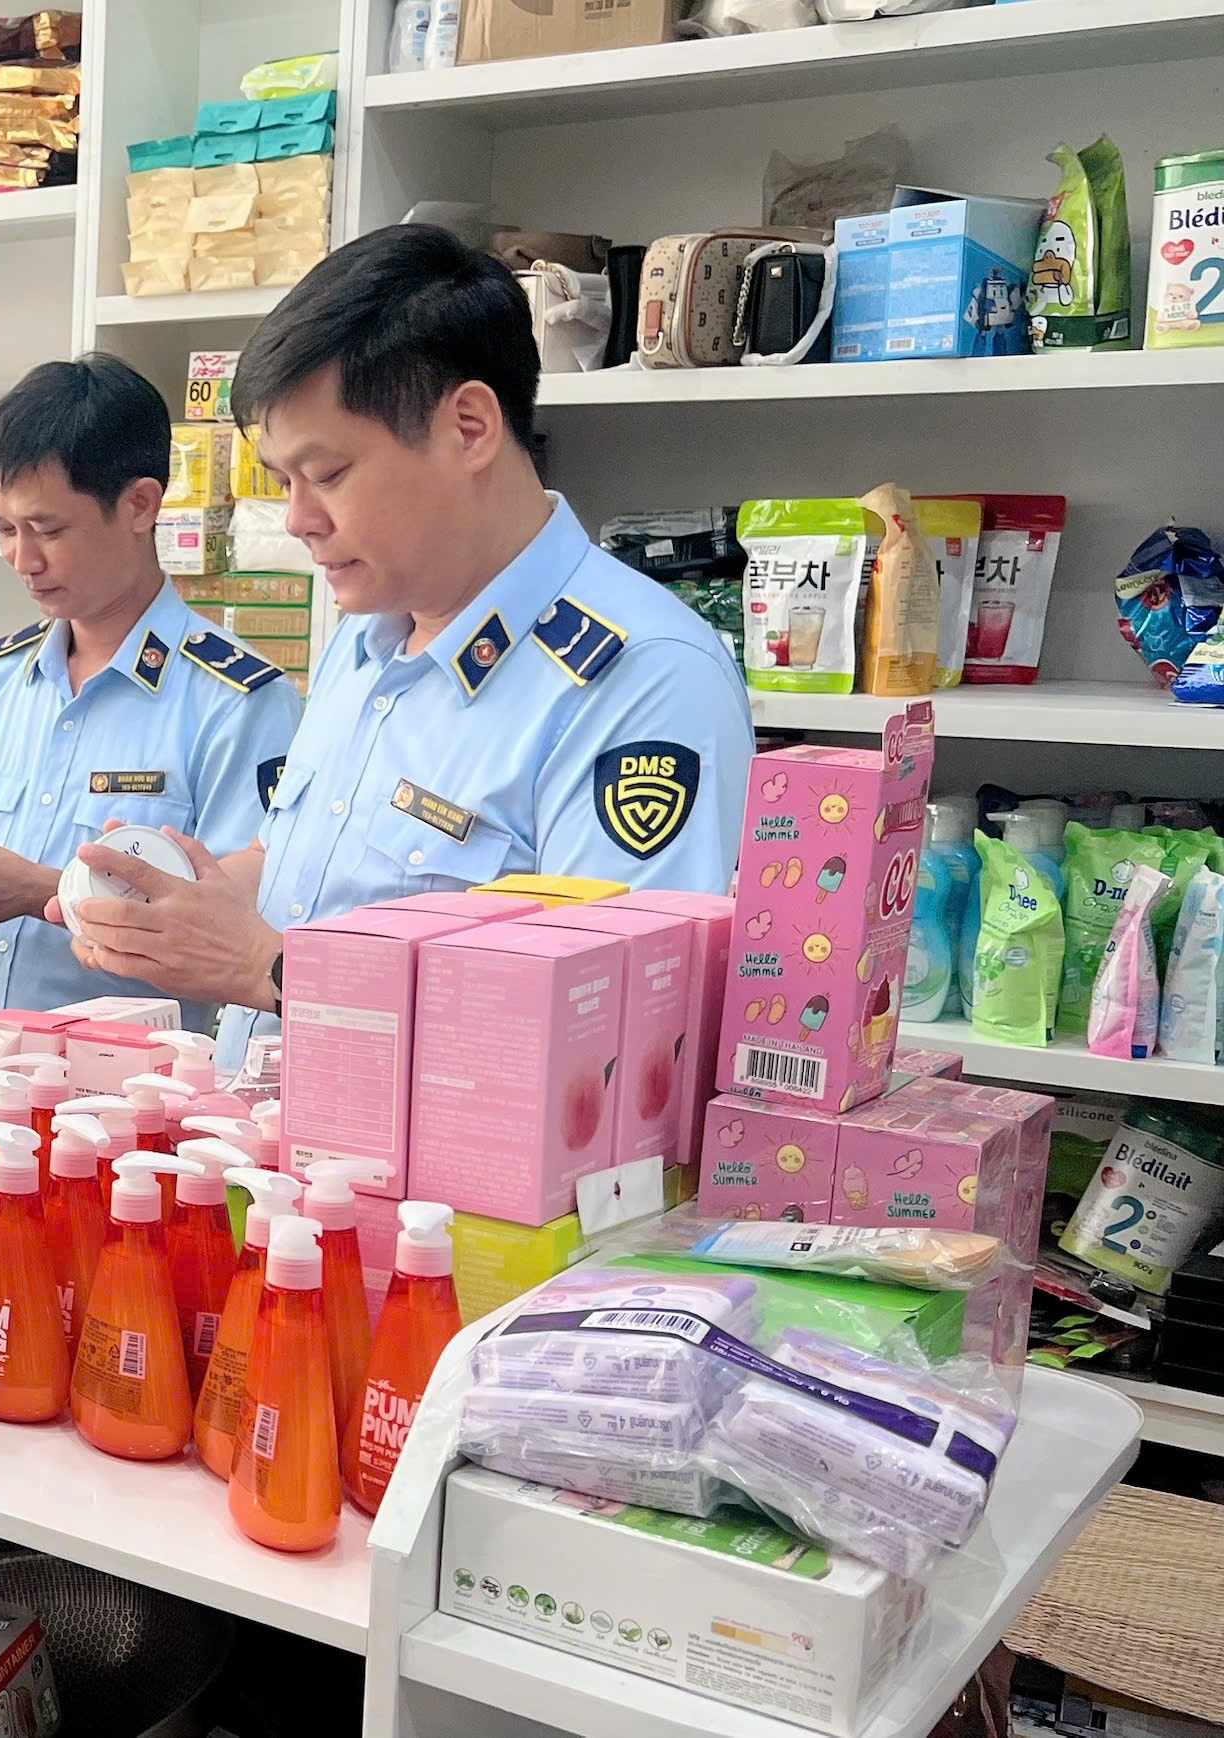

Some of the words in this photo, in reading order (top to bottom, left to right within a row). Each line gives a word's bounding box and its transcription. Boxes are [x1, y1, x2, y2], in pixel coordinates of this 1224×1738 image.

[189, 381, 211, 401] 60
[749, 558, 830, 591] 콤부차
[620, 755, 676, 777] DMS
[760, 816, 793, 827] Hello
[754, 830, 800, 842] SUMMER
[745, 953, 778, 964] Hello
[739, 967, 784, 978] SUMMER
[718, 1161, 751, 1173] Hello
[1115, 1143, 1193, 1192] Blédilait
[712, 1174, 758, 1186] SUMMER
[893, 1192, 928, 1205] Hello
[887, 1205, 936, 1219] SUMMER
[1101, 1195, 1144, 1255] 2
[364, 1385, 421, 1427] PUM
